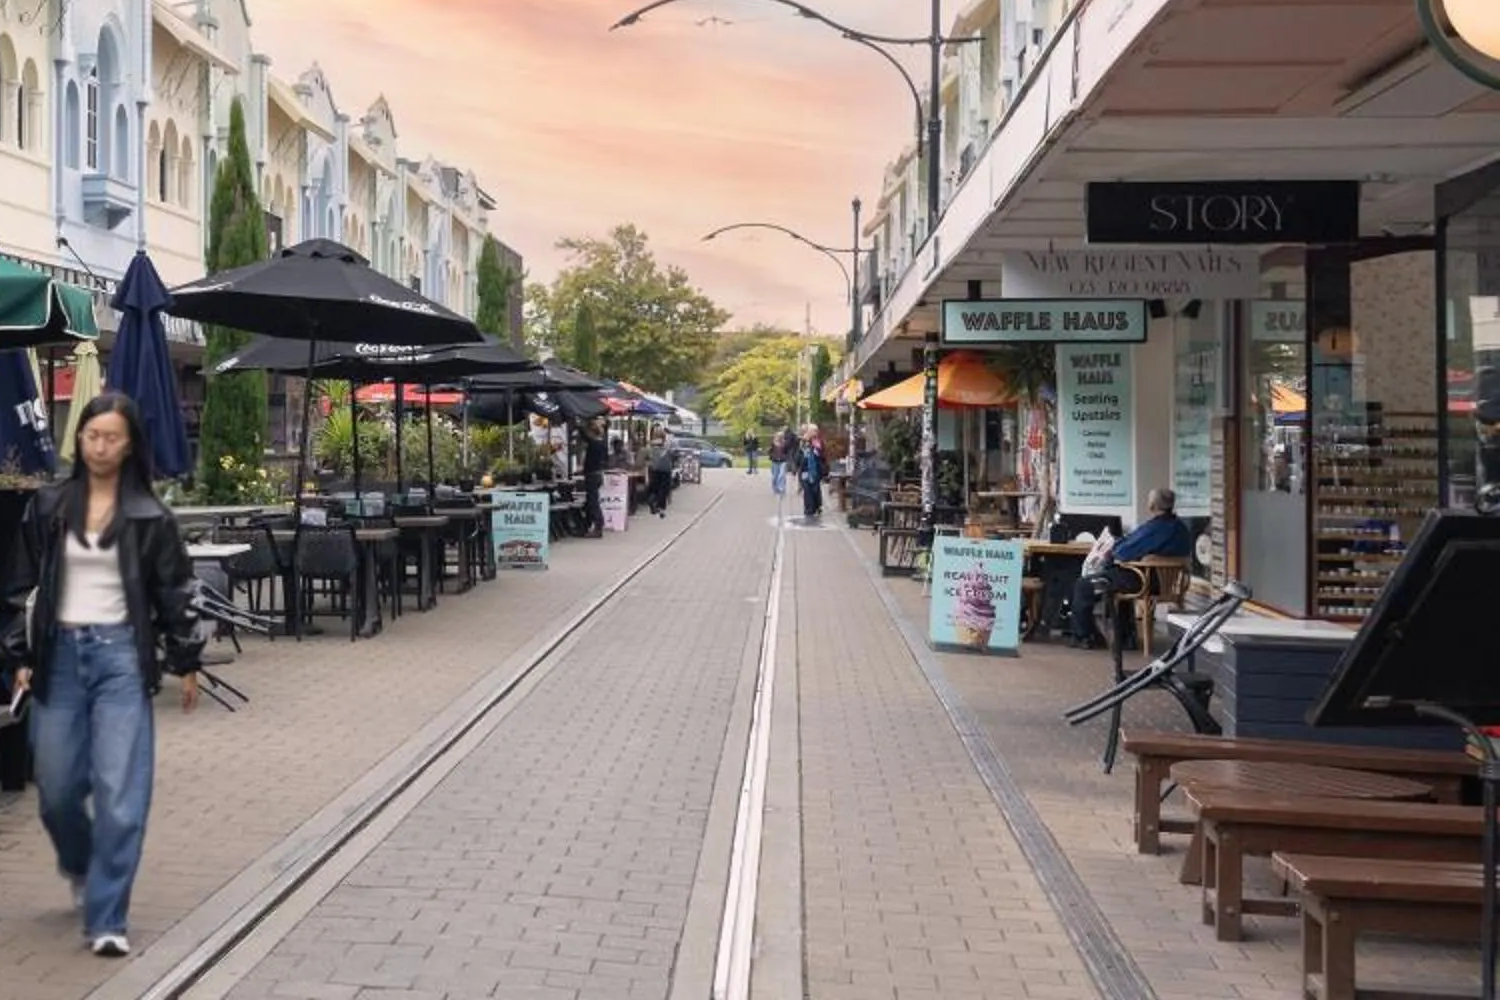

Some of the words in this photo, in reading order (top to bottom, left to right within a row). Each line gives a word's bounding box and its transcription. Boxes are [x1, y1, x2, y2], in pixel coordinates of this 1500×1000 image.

[1150, 194, 1286, 232] STORY
[1022, 250, 1072, 273] NEW
[1084, 254, 1173, 275] REGENT
[1176, 250, 1242, 274] NAILS
[961, 311, 1052, 332] WAFFLE
[1062, 311, 1130, 332] HAUS
[1070, 352, 1121, 369] WAFFLE
[1077, 370, 1114, 386] HAUS
[1073, 392, 1119, 407] Seating
[1071, 408, 1121, 424] Upstairs
[503, 513, 537, 525] HAUS
[943, 546, 984, 559] WAFFLE
[985, 549, 1014, 561] HAUS
